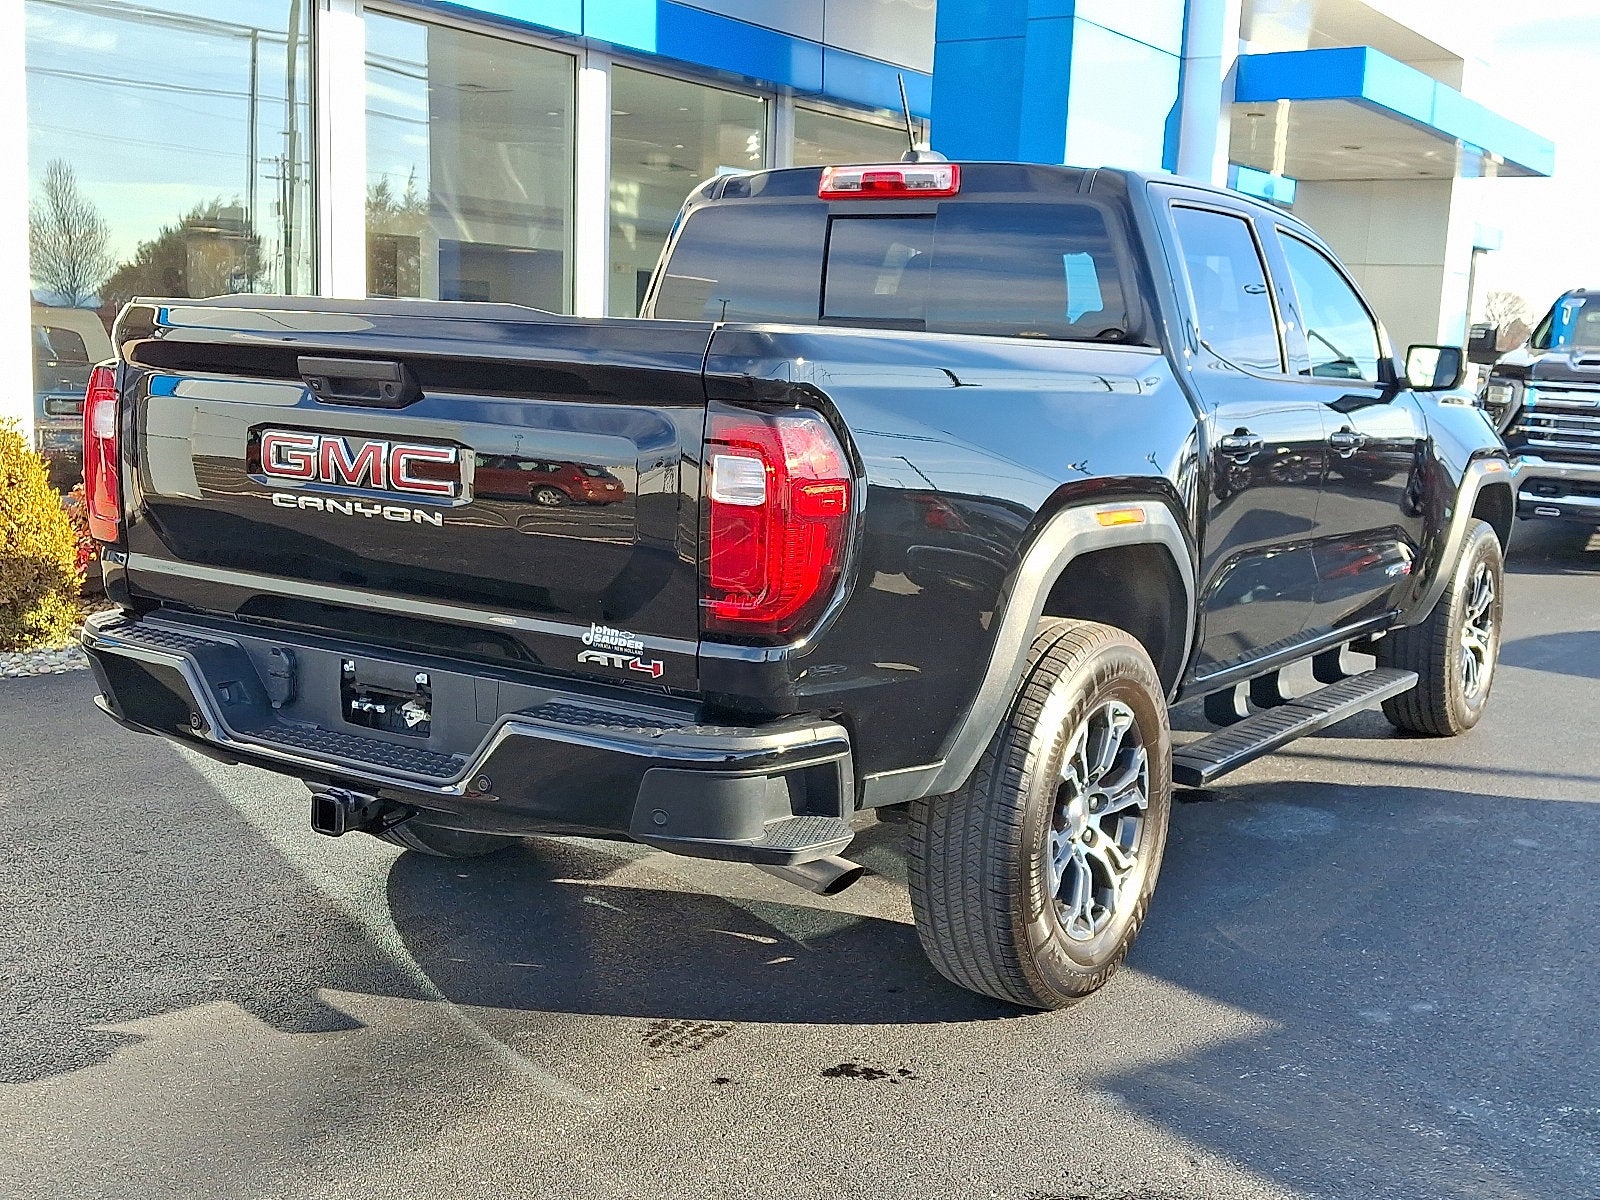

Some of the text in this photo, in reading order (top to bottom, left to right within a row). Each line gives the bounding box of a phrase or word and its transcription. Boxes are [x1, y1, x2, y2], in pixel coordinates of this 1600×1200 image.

[262, 429, 457, 498] GMC
[272, 493, 443, 527] CANYON
[582, 622, 619, 645] John
[593, 633, 644, 650] SAUDER
[577, 650, 664, 679] AT4
